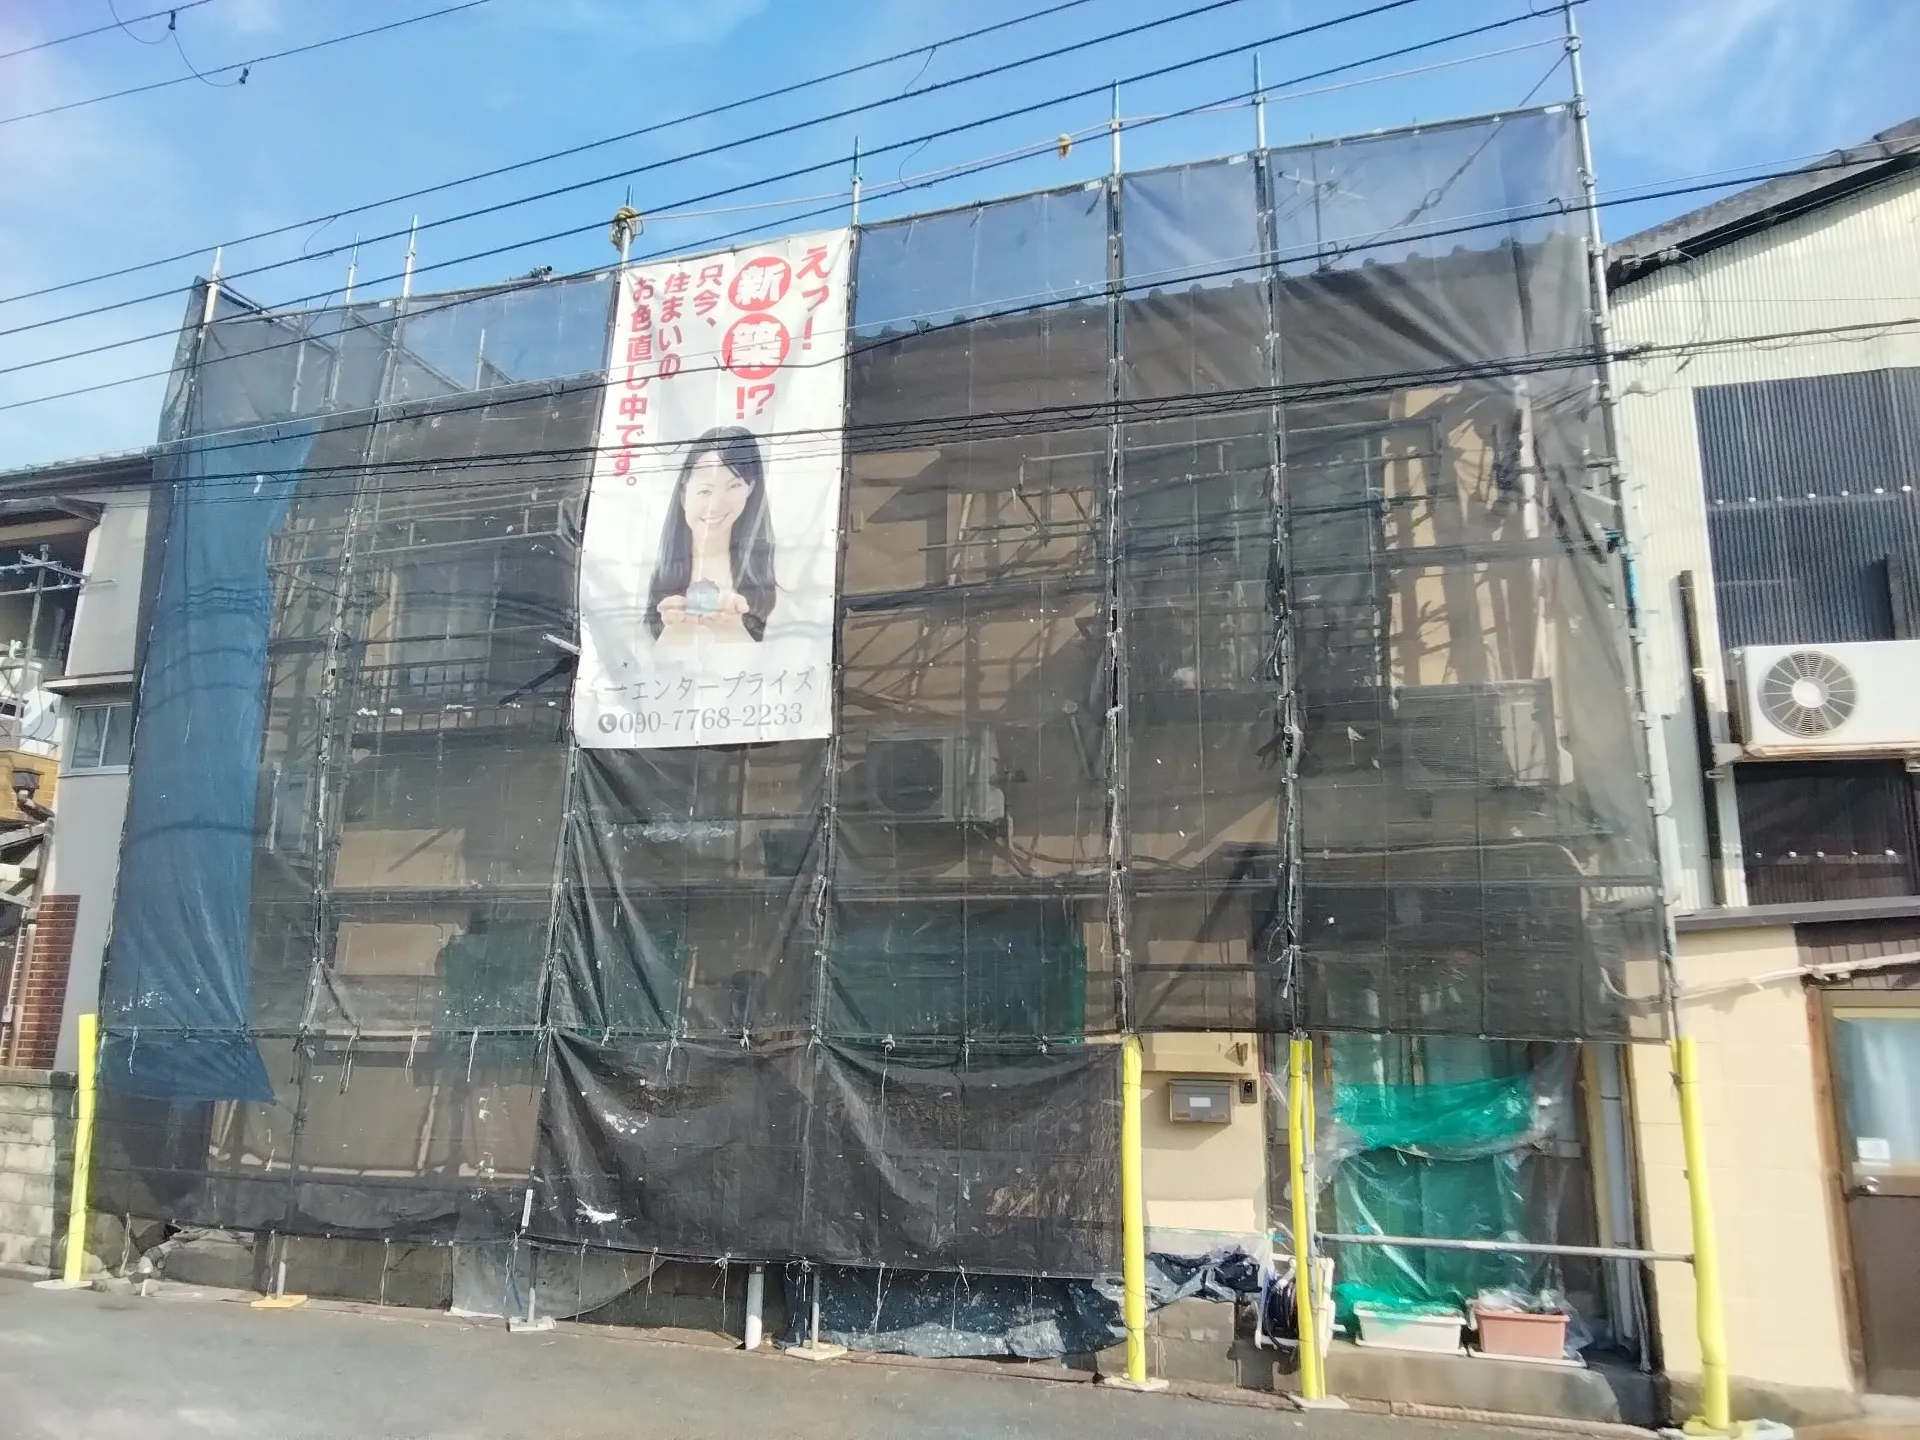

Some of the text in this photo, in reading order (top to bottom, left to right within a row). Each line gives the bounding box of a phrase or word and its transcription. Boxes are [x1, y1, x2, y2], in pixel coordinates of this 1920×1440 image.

[658, 272, 692, 380] 住まいの
[693, 263, 724, 328] 只今、
[613, 276, 656, 487] お色直し中です。
[620, 702, 803, 734] 090-7768-2233
